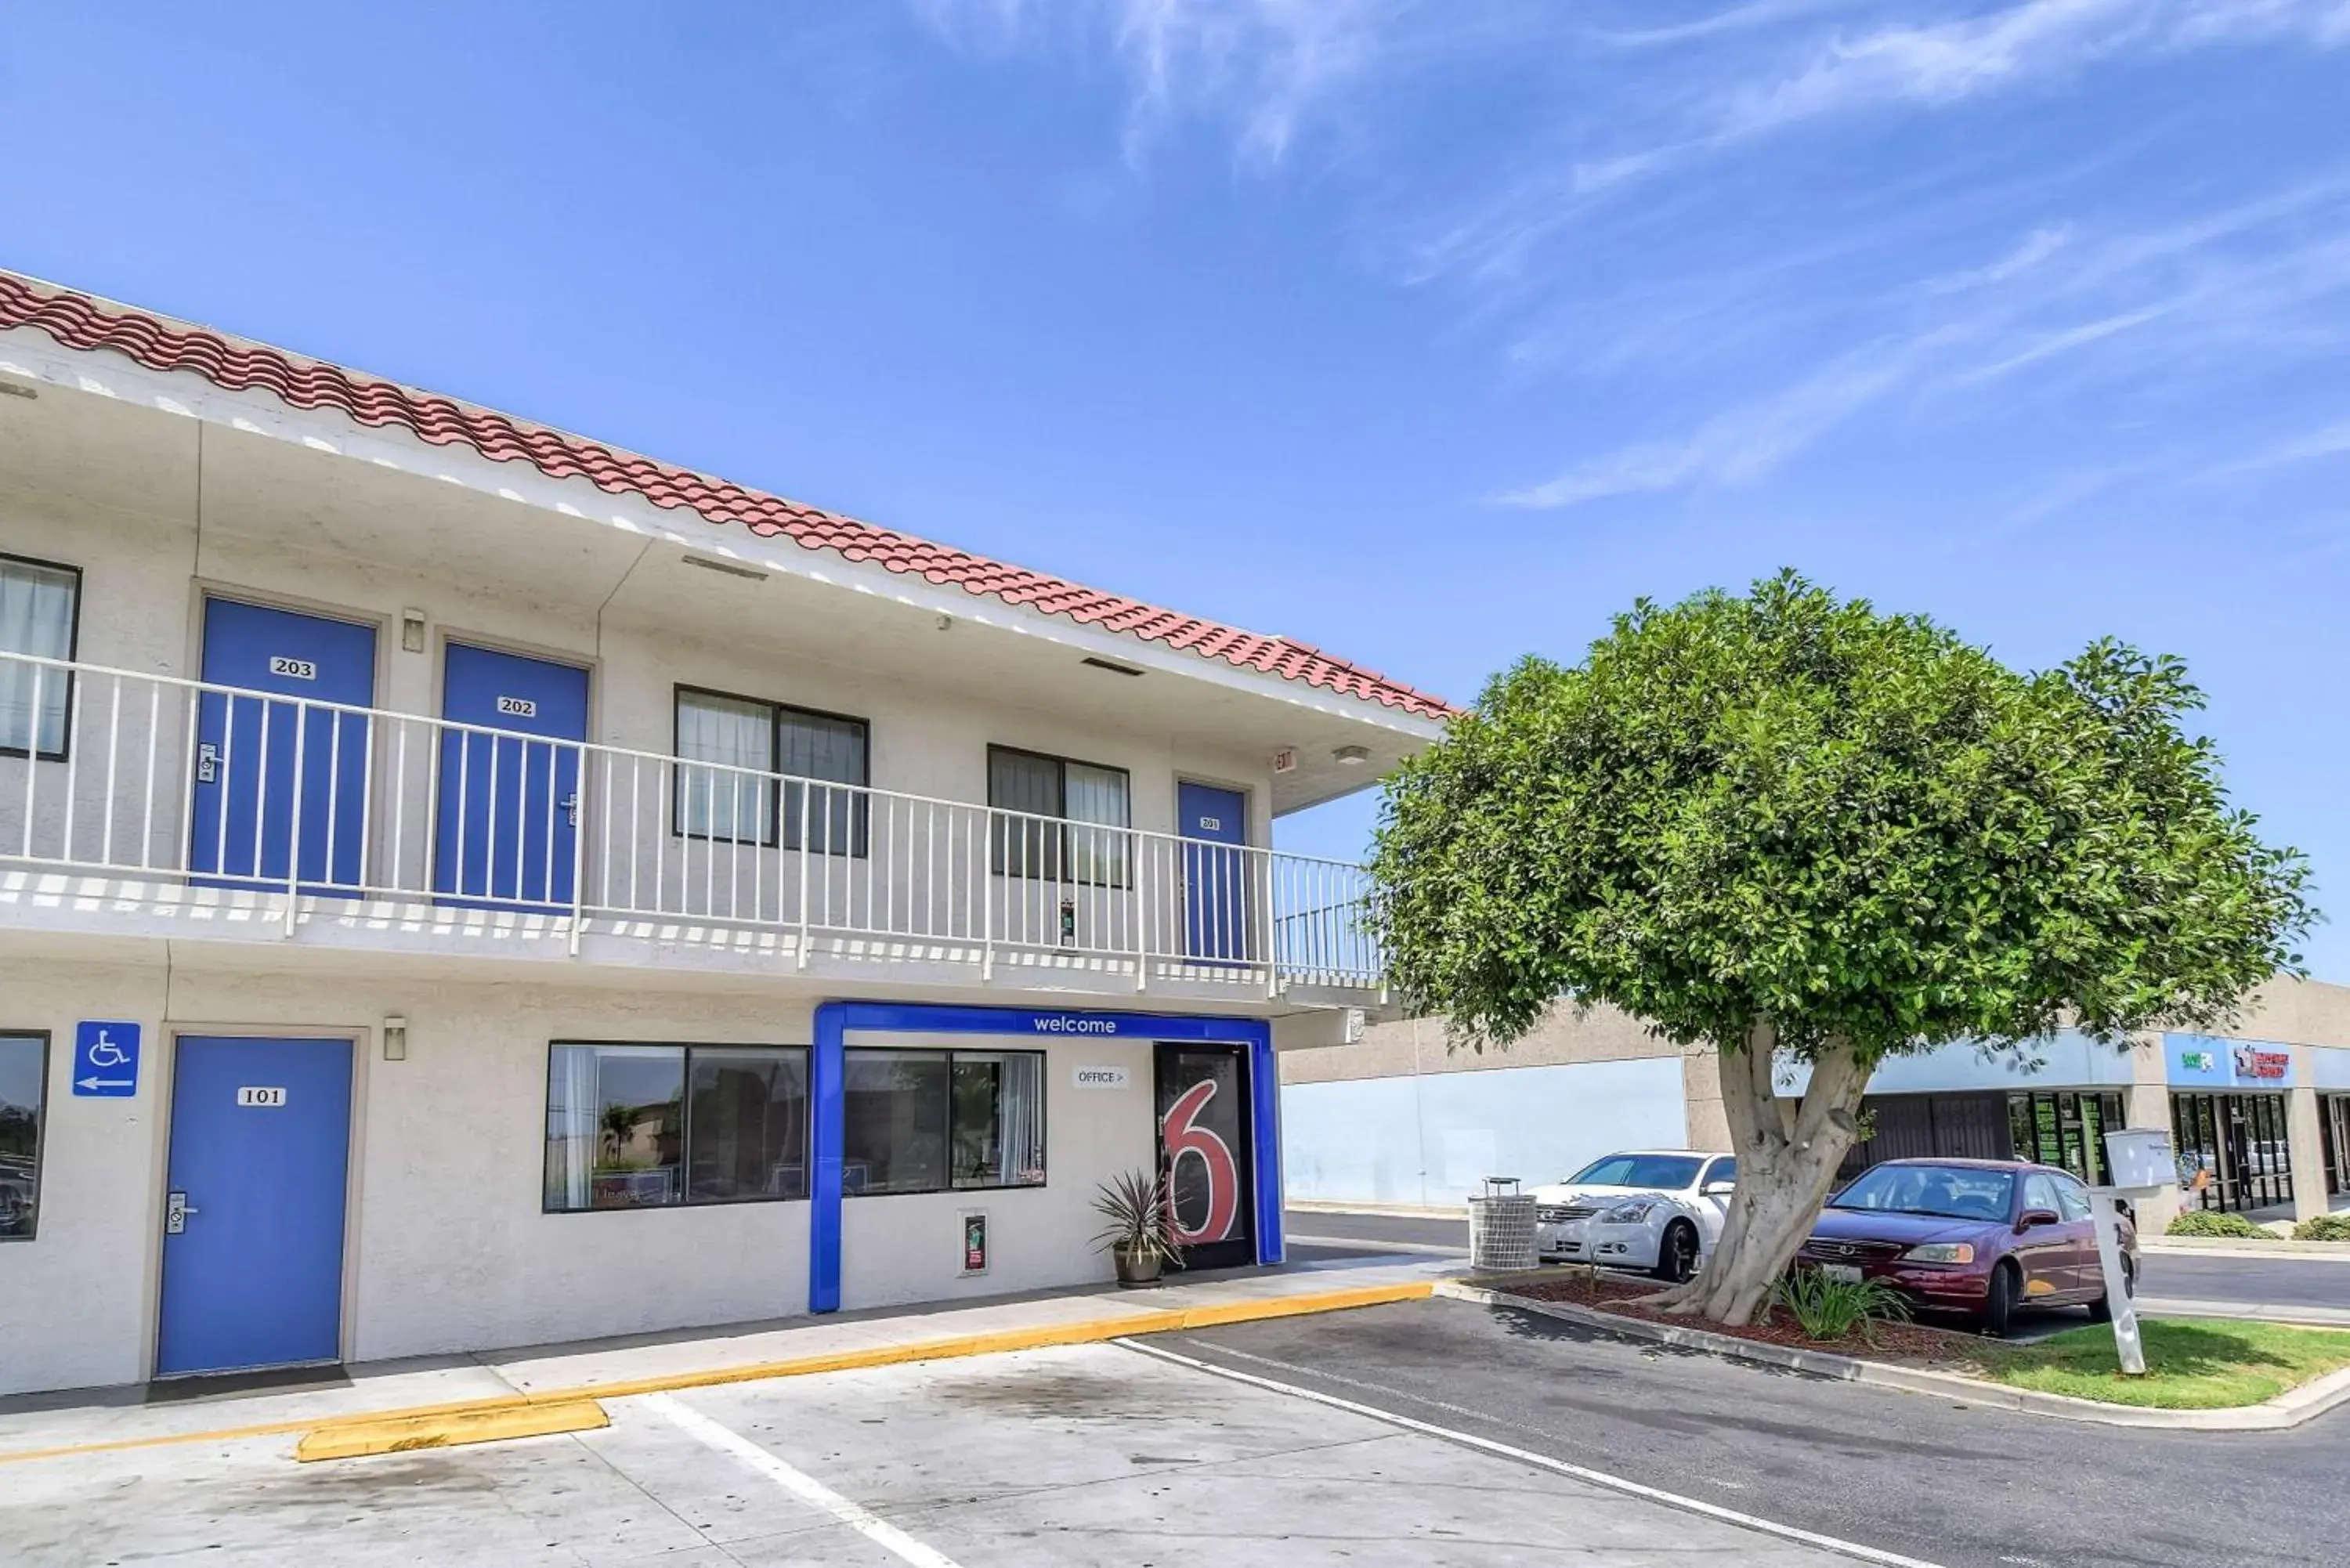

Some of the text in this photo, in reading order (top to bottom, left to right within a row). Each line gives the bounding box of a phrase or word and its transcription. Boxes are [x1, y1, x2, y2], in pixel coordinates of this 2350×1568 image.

[275, 659, 312, 676] 203
[501, 699, 533, 715] 202
[1202, 818, 1218, 829] 201
[1034, 1016, 1116, 1033] welcome
[1079, 1071, 1115, 1082] OFFICE
[246, 1089, 278, 1104] 101
[1163, 1078, 1238, 1245] 6
